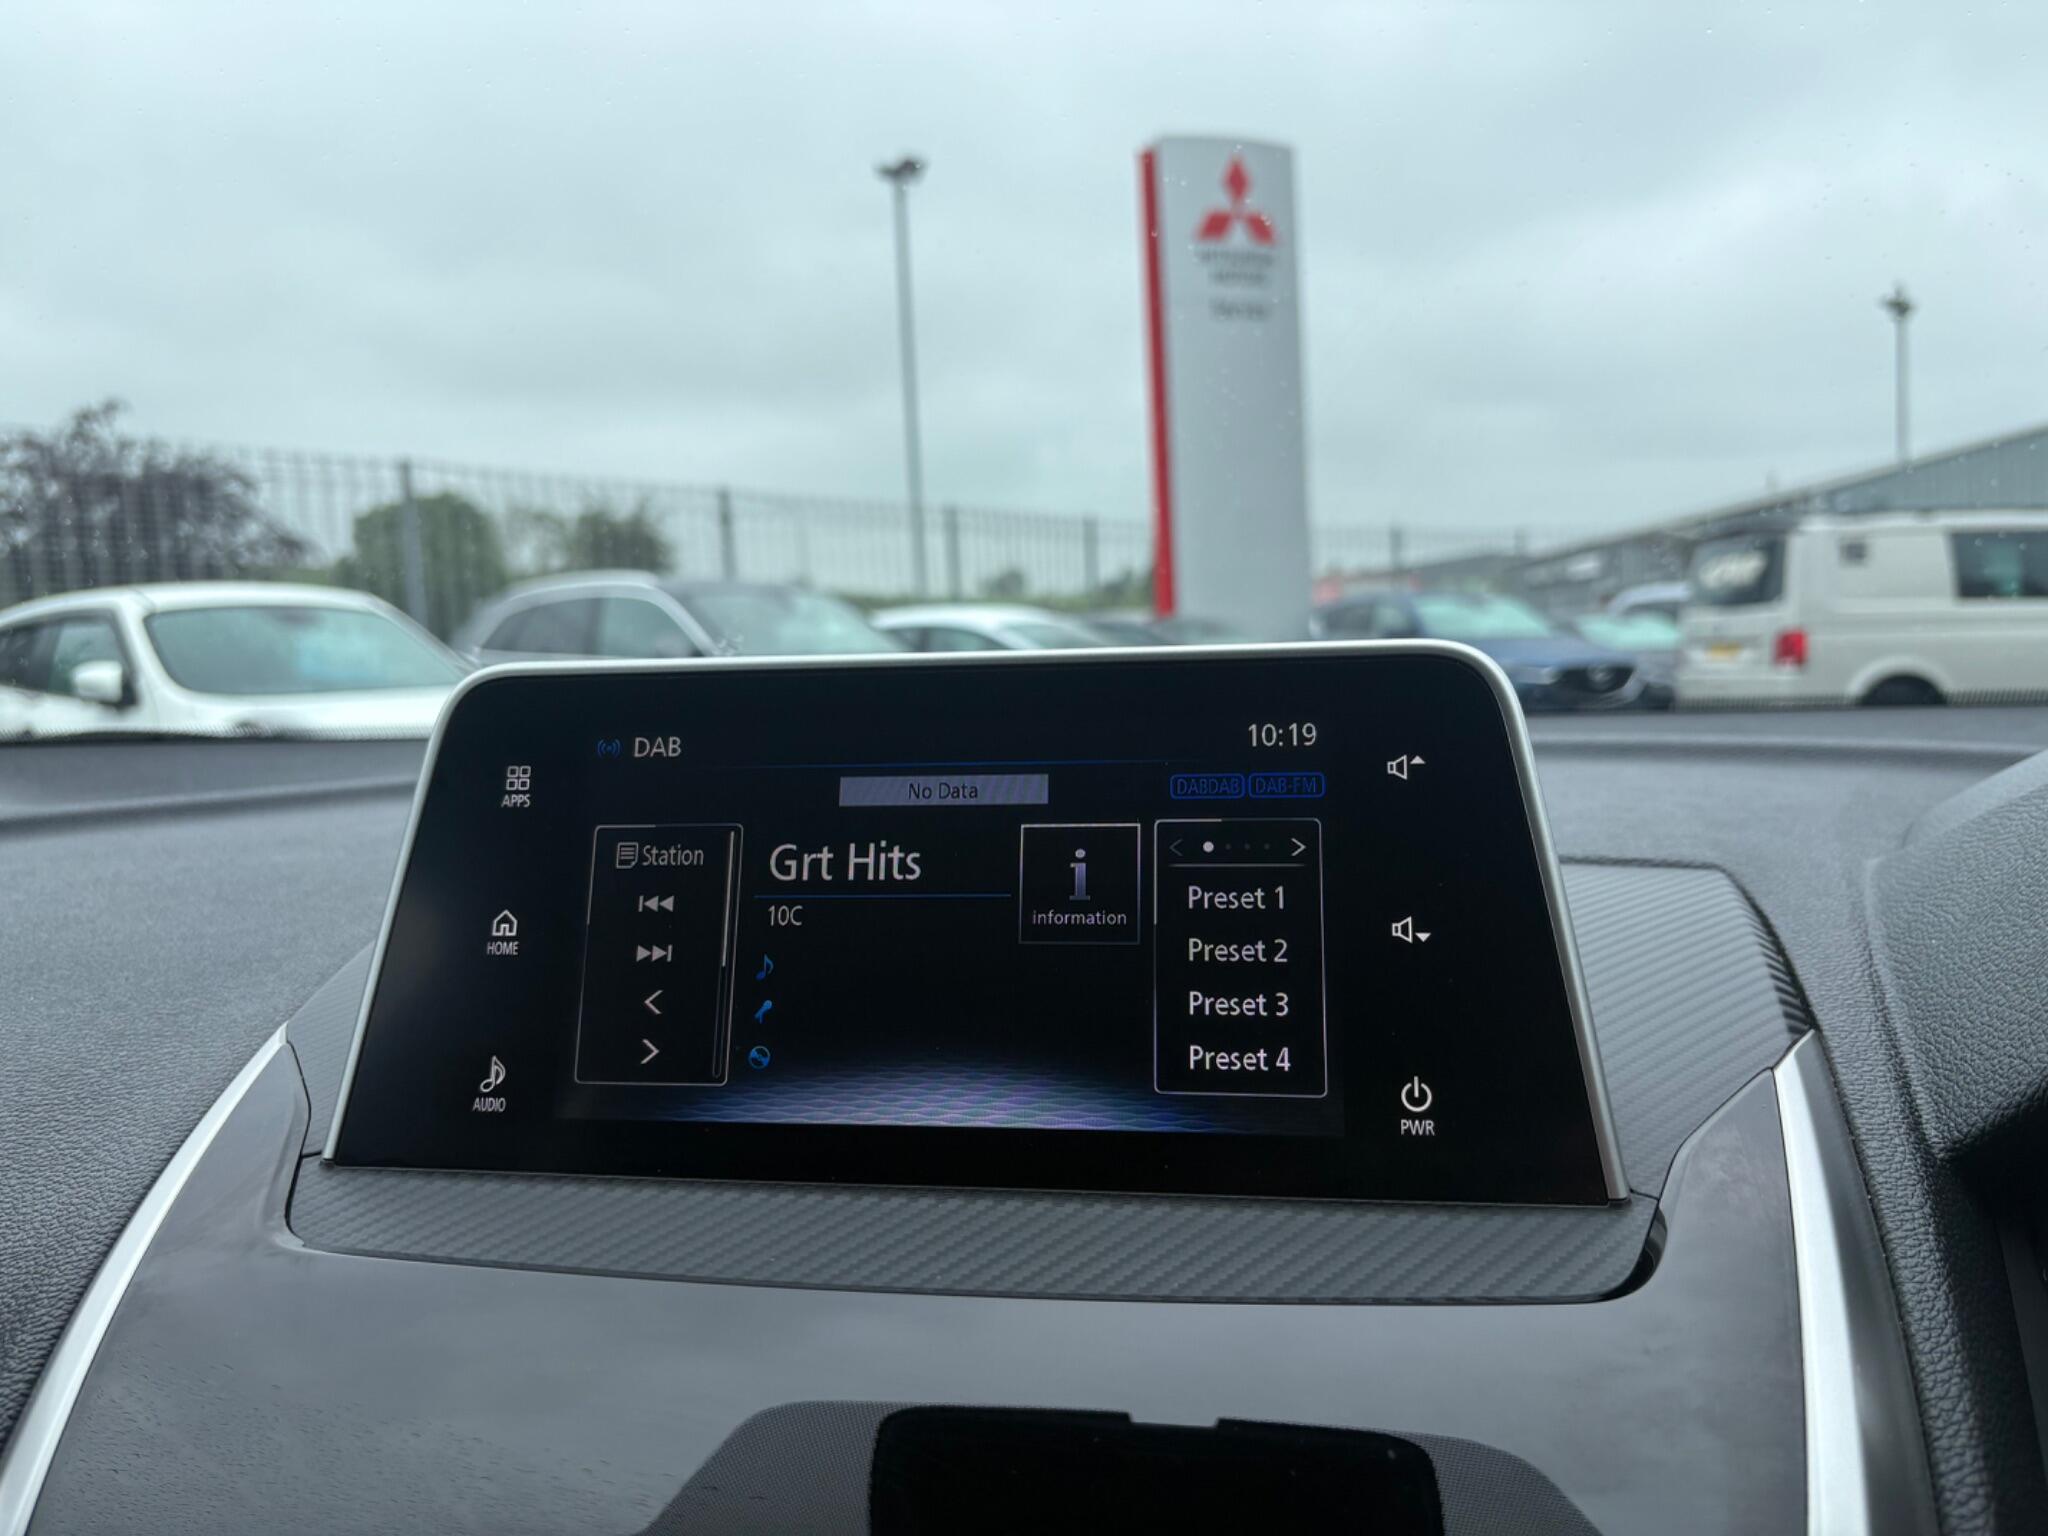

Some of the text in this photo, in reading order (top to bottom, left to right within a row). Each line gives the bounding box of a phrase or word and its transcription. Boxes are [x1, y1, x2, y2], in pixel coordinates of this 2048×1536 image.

[1248, 722, 1317, 747] 10:19
[633, 736, 682, 758] DAB
[501, 793, 531, 808] APPS
[908, 781, 979, 800] No Data
[642, 843, 704, 866] Station
[769, 840, 922, 881] Grt Hits
[1188, 885, 1285, 910] Preset 1
[768, 905, 803, 926] 10C
[1032, 909, 1128, 926] information
[486, 940, 519, 956] HOME
[1188, 937, 1288, 963] Preset 2
[1189, 990, 1290, 1017] Preset 3
[1189, 1044, 1291, 1072] Preset 4
[472, 1096, 508, 1113] AUDIO
[1400, 1119, 1435, 1137] PWR
